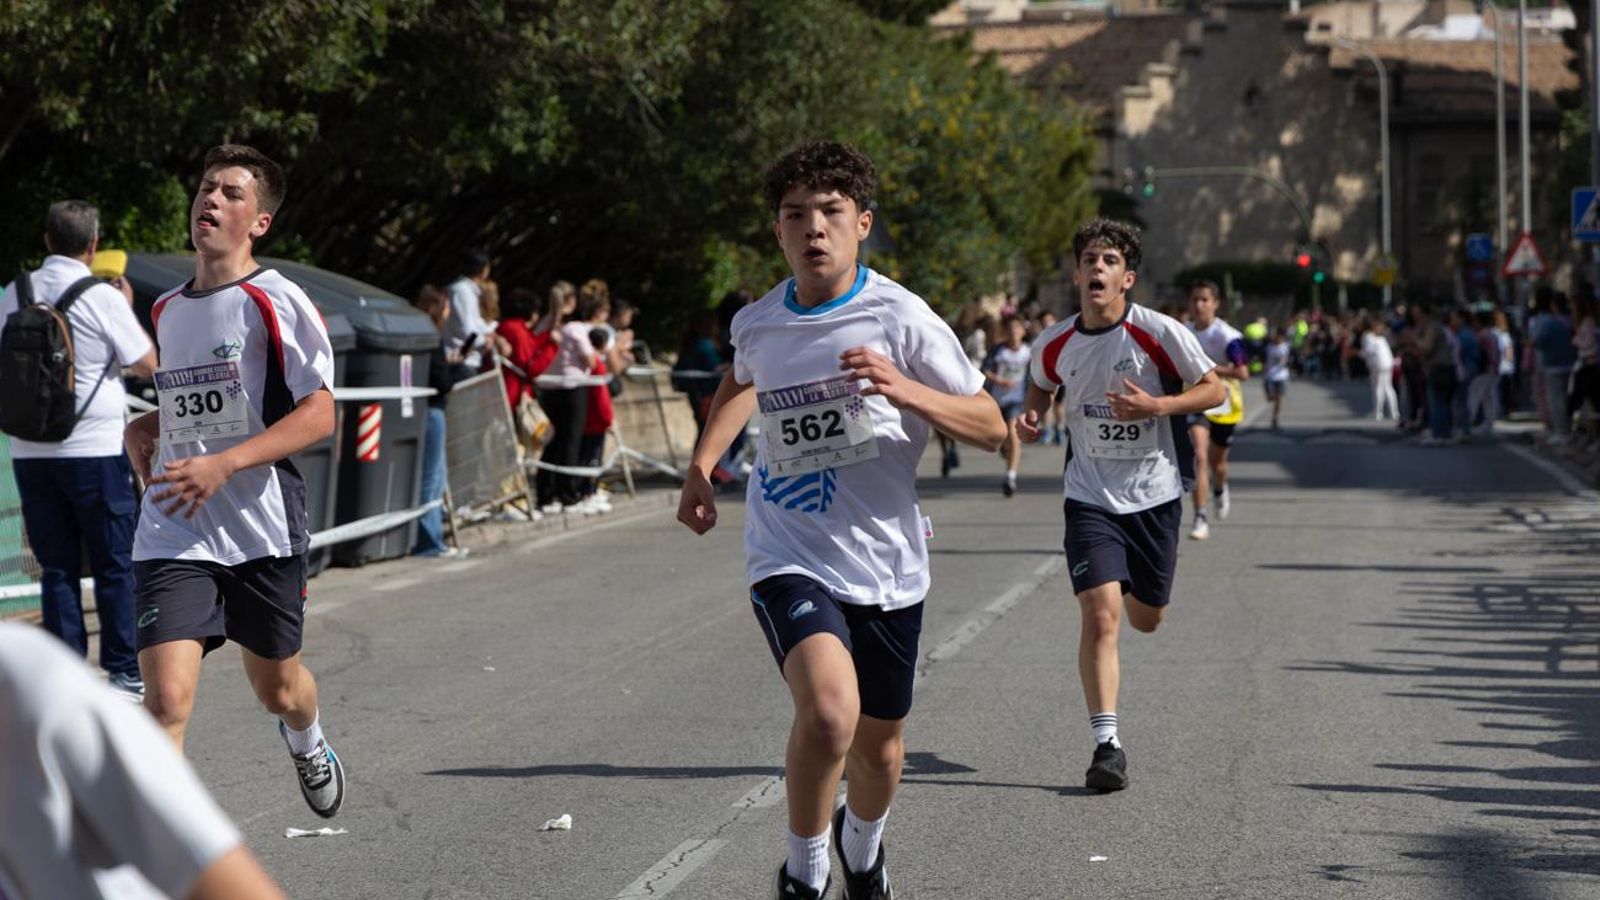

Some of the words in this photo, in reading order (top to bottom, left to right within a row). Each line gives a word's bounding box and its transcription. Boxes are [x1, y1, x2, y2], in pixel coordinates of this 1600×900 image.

[174, 390, 224, 418] 330
[781, 409, 845, 446] 562
[1098, 423, 1140, 441] 329
